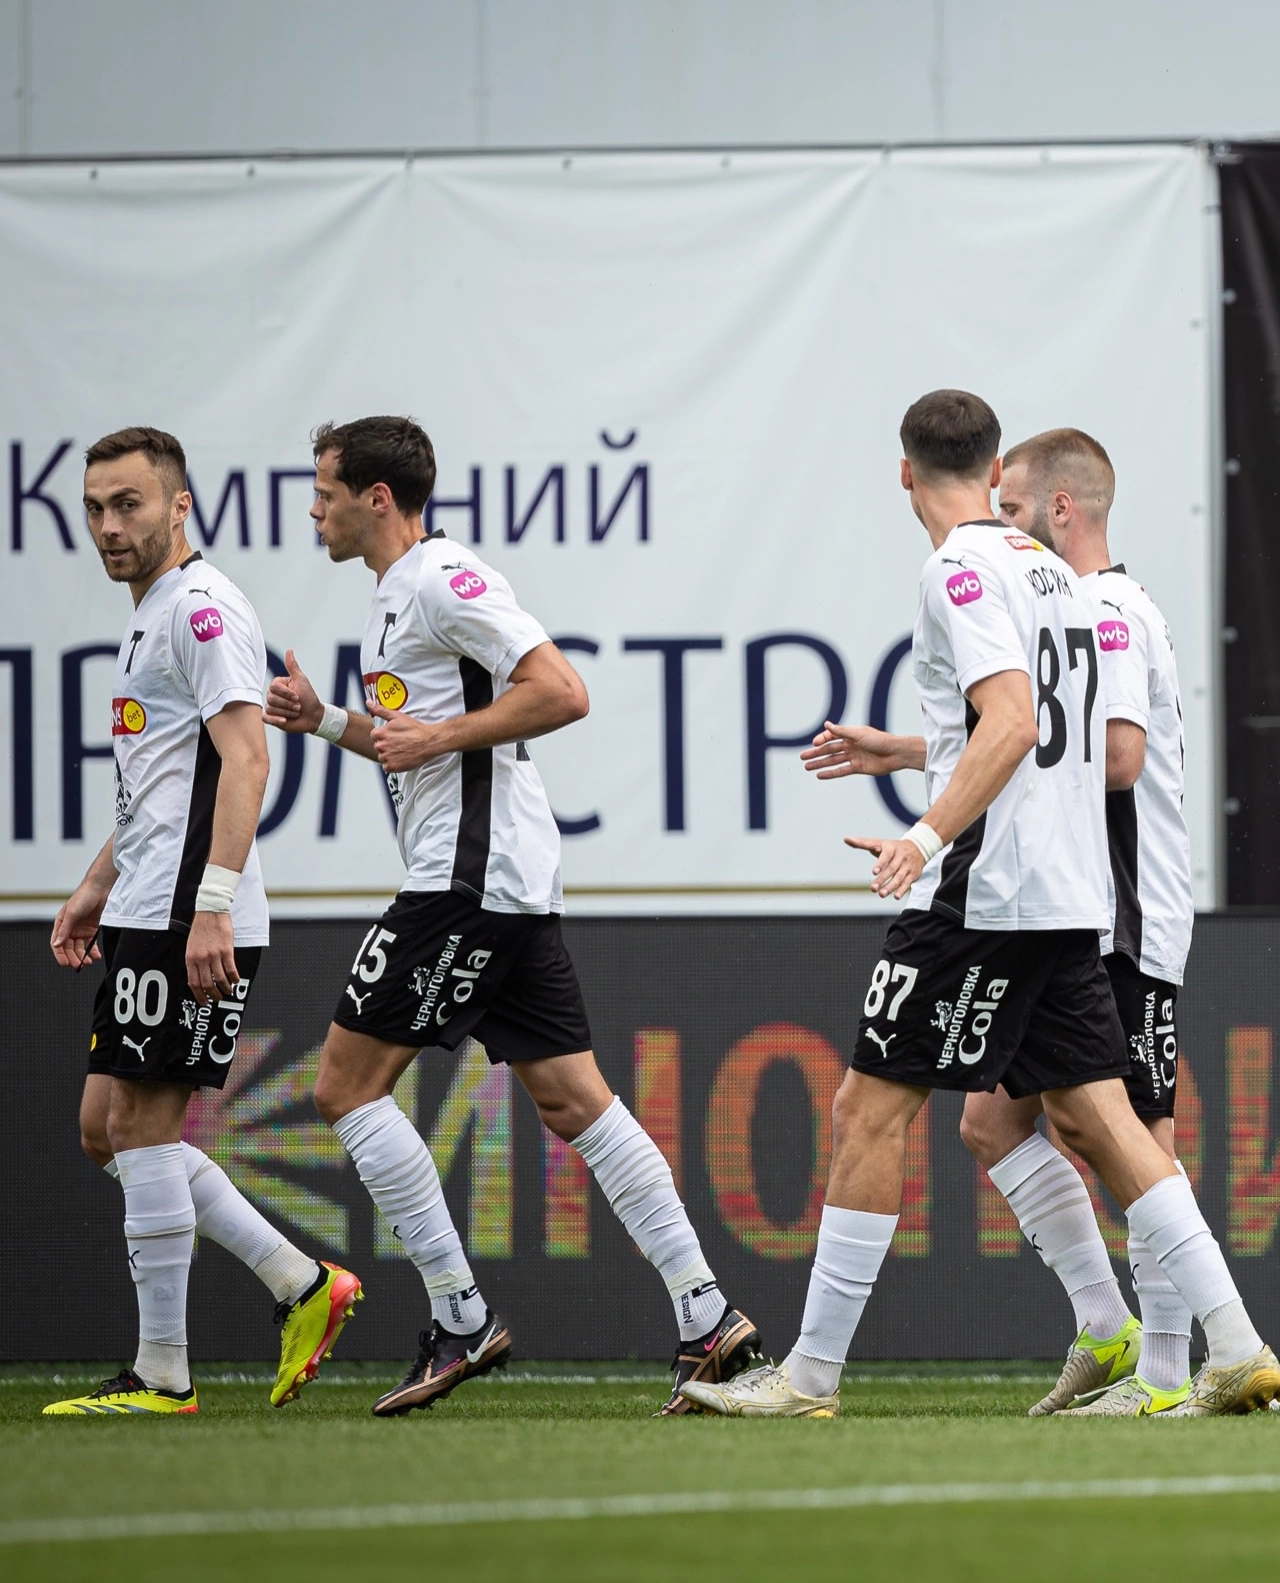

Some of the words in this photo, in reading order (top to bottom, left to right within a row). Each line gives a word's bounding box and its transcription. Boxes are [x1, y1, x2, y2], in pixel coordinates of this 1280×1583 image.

[8, 429, 652, 552] Кмпний
[454, 576, 482, 595] wb
[949, 576, 980, 598] wb
[193, 613, 221, 634] wb
[1099, 625, 1128, 643] wb
[126, 709, 141, 723] bet
[381, 683, 401, 701] bet
[1035, 627, 1098, 769] 87
[351, 924, 397, 983] 15
[410, 934, 463, 1031] ЧЕРНОГОЛОВКА
[114, 967, 168, 1027] 80
[436, 949, 493, 1026] Cola
[864, 959, 919, 1022] 87
[936, 965, 982, 1069] ЧЕРНОГОЛОВКА
[208, 978, 250, 1064] Cola
[958, 978, 1009, 1065] Cola
[1155, 998, 1177, 1088] Cola
[448, 1292, 465, 1325] DESIGN
[681, 1293, 694, 1324] ESIGN
